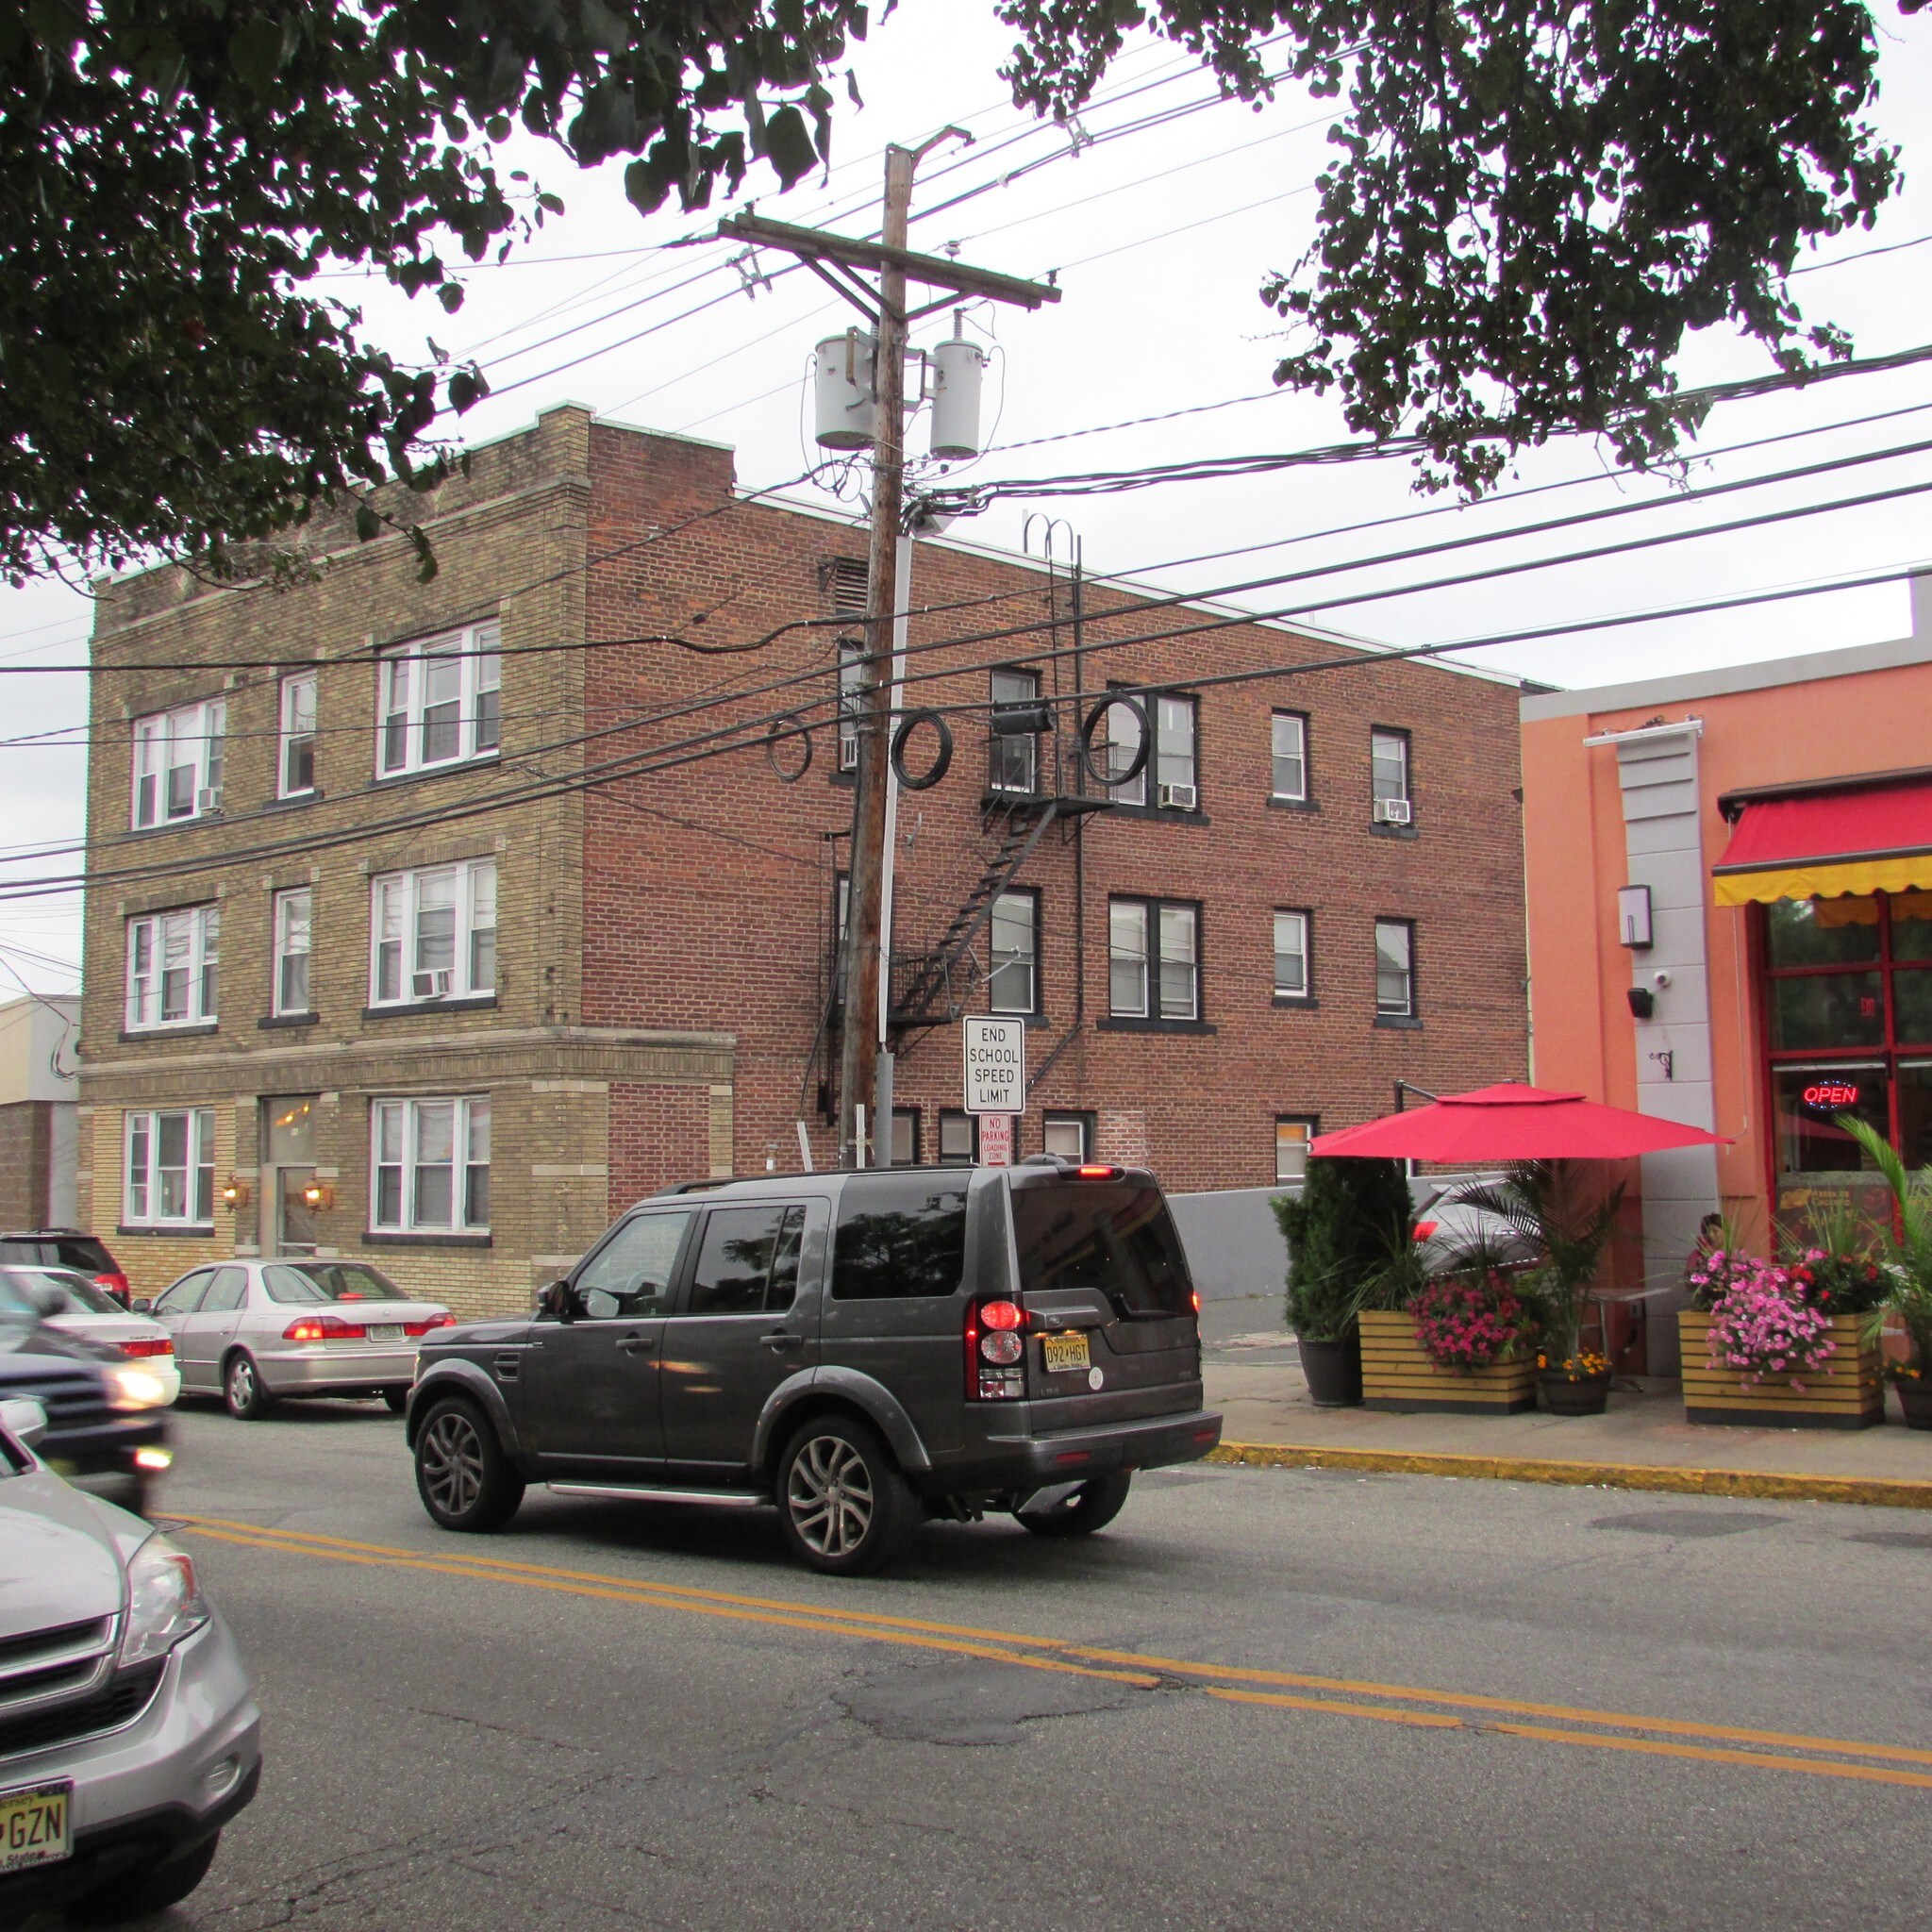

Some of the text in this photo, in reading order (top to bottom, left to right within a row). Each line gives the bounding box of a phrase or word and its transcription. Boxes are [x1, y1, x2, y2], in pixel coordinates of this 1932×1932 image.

[982, 1028, 1006, 1042] END
[970, 1048, 1019, 1063] SCHOOL
[974, 1069, 1014, 1083] SPEED
[979, 1089, 1009, 1103] LIMIT
[1804, 1087, 1857, 1103] OPEN
[989, 1118, 1001, 1128] NO
[981, 1130, 1009, 1142] PARKING
[983, 1143, 1008, 1152] LOADING
[989, 1152, 1003, 1160] ZONE
[1069, 1344, 1087, 1361] HGT
[0, 1793, 35, 1809] ersey
[10, 1803, 61, 1849] GZN
